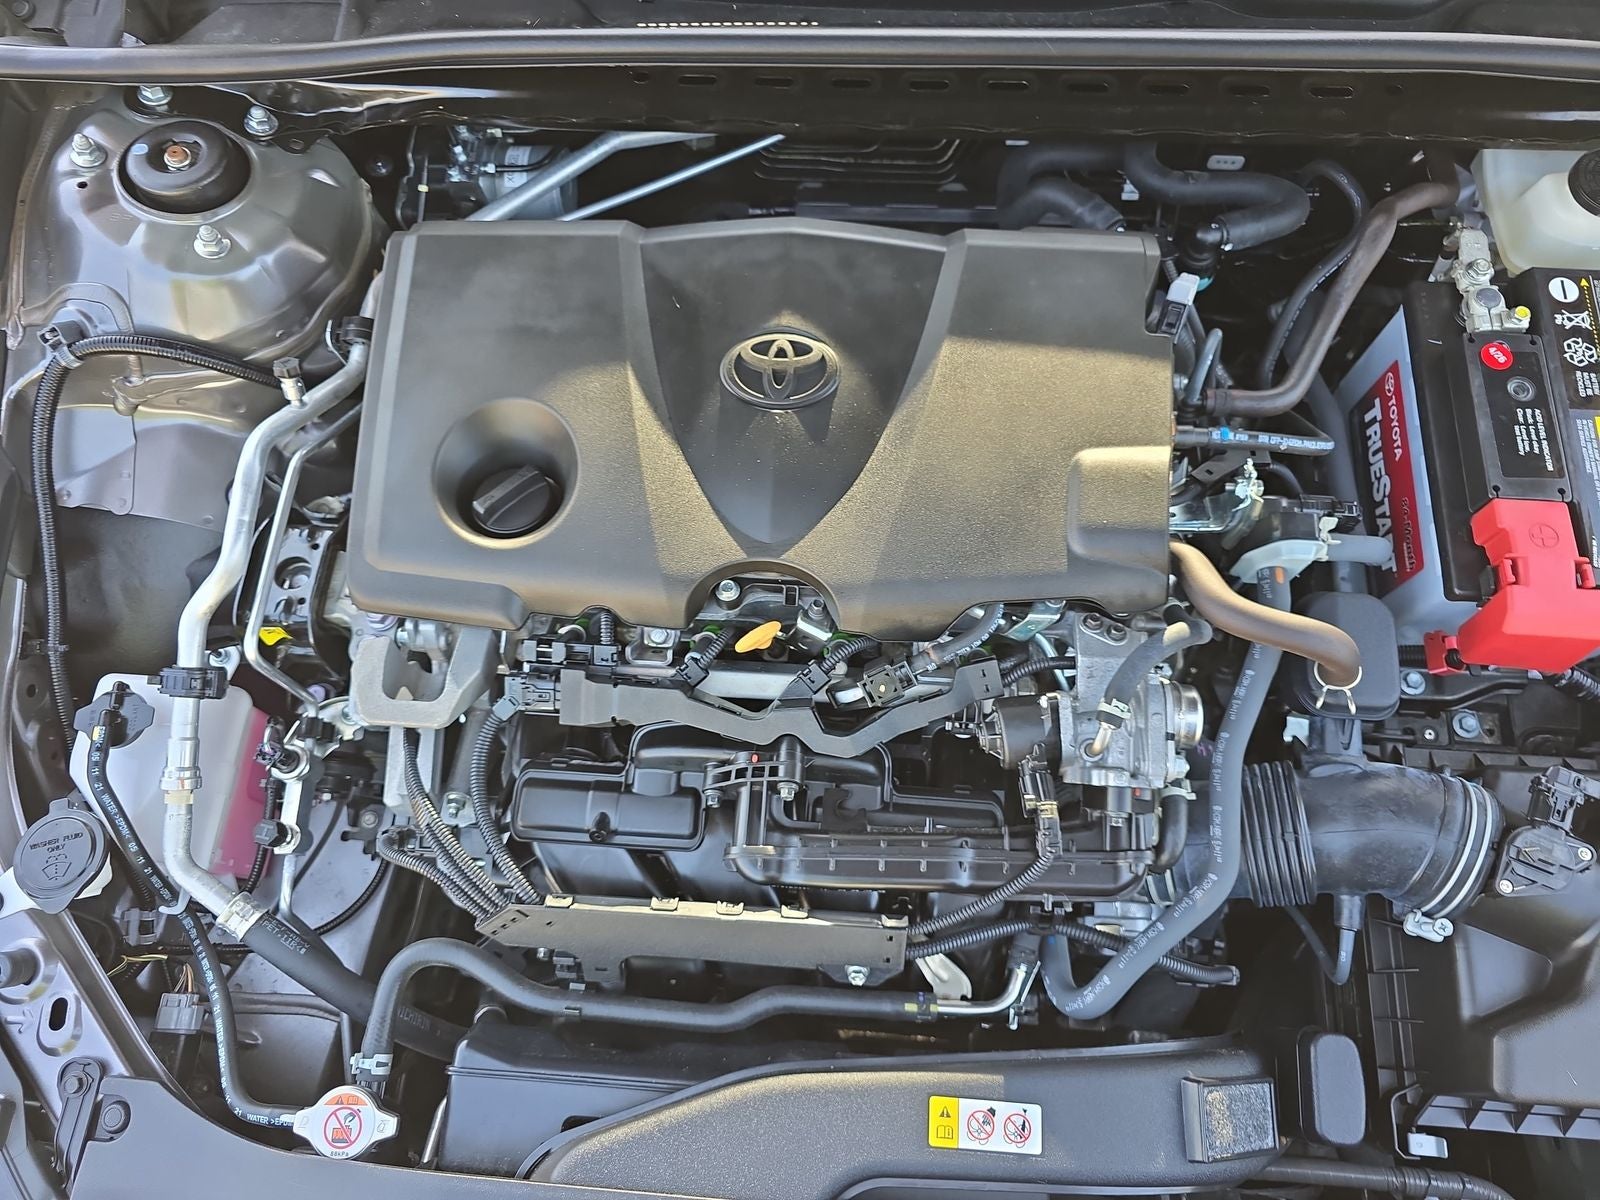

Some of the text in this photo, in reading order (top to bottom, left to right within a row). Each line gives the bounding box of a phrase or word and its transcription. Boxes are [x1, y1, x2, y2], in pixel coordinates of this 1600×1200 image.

[1488, 347, 1507, 363] 4/26
[1575, 370, 1586, 397] RECYCLED
[1583, 371, 1592, 388] MUST
[1590, 372, 1600, 396] BATTERY
[1388, 396, 1402, 462] TOYOTA
[1520, 425, 1529, 440] Level
[1529, 425, 1538, 440] Level
[1516, 436, 1525, 456] battery
[1532, 440, 1540, 454] okay
[1534, 408, 1554, 471] ACID LEVEL INDICATOR
[91, 752, 100, 761] 05
[94, 782, 104, 792] 21
[101, 793, 118, 815] WATER
[29, 832, 83, 850] WASHER FLUID
[47, 843, 65, 853] ONLY
[216, 1016, 224, 1043] WATER
[234, 1107, 243, 1116] 21
[247, 1113, 269, 1126] WATER
